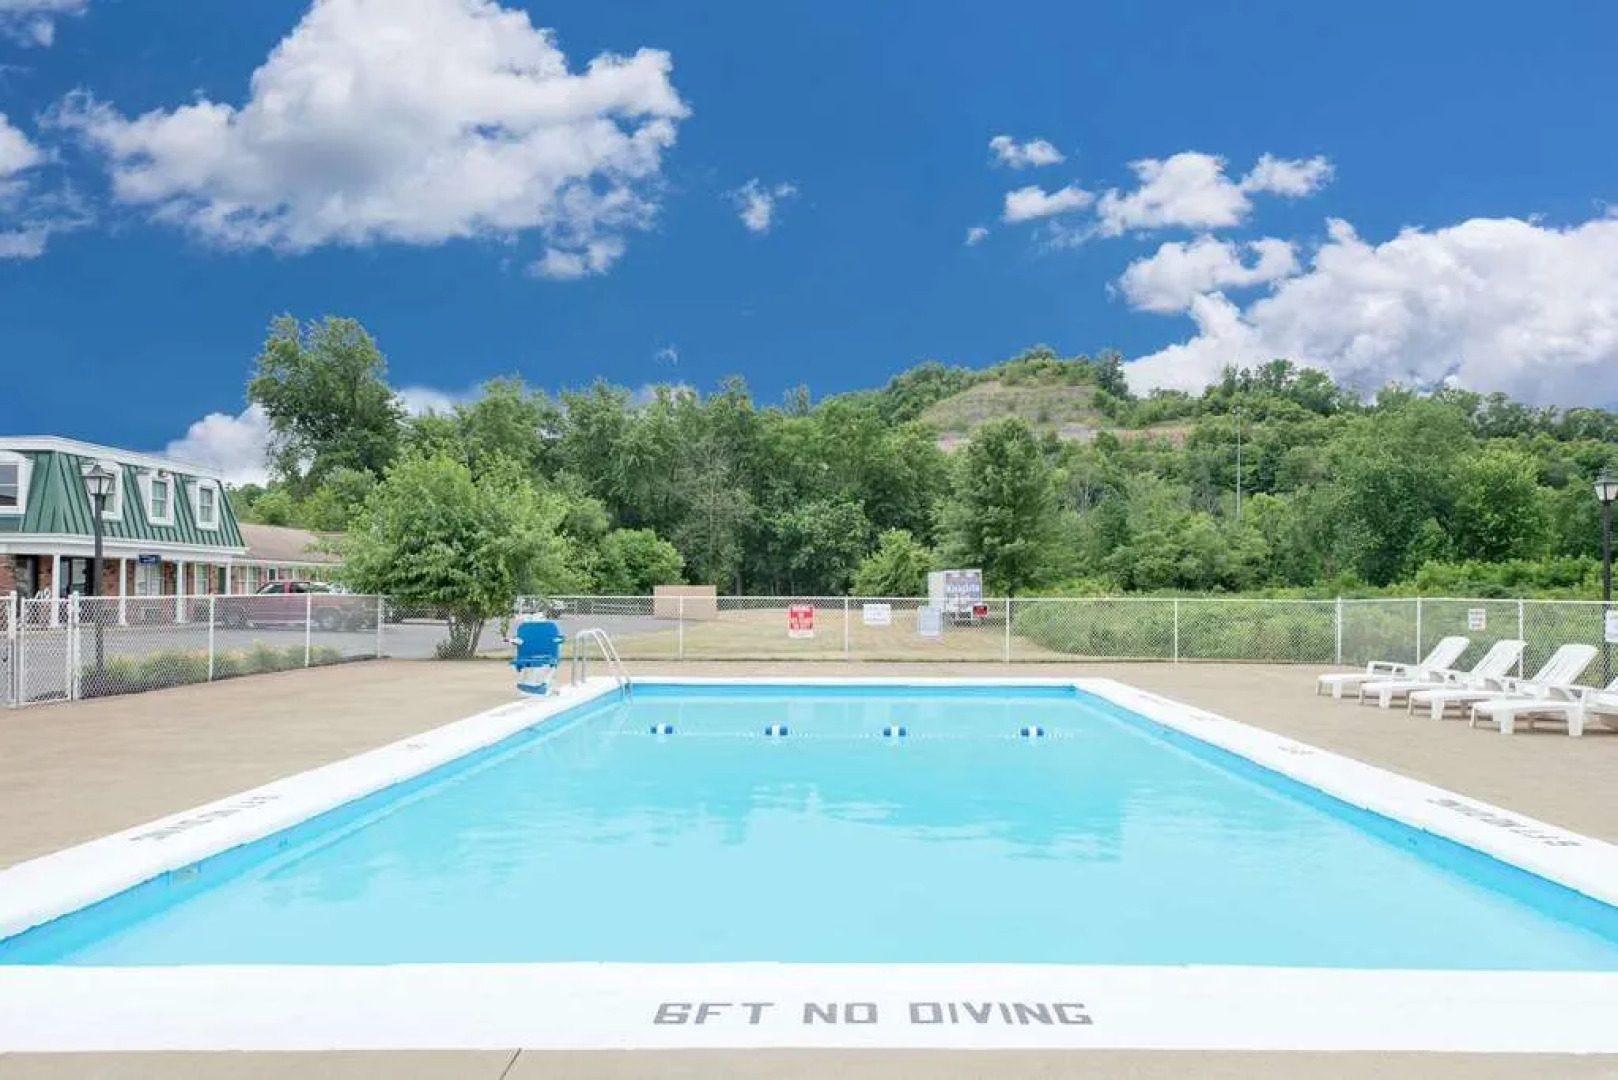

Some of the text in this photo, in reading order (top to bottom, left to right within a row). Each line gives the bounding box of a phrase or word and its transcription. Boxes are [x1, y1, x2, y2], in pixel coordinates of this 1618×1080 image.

[653, 1002, 1093, 1025] 6FT NO DIVING
